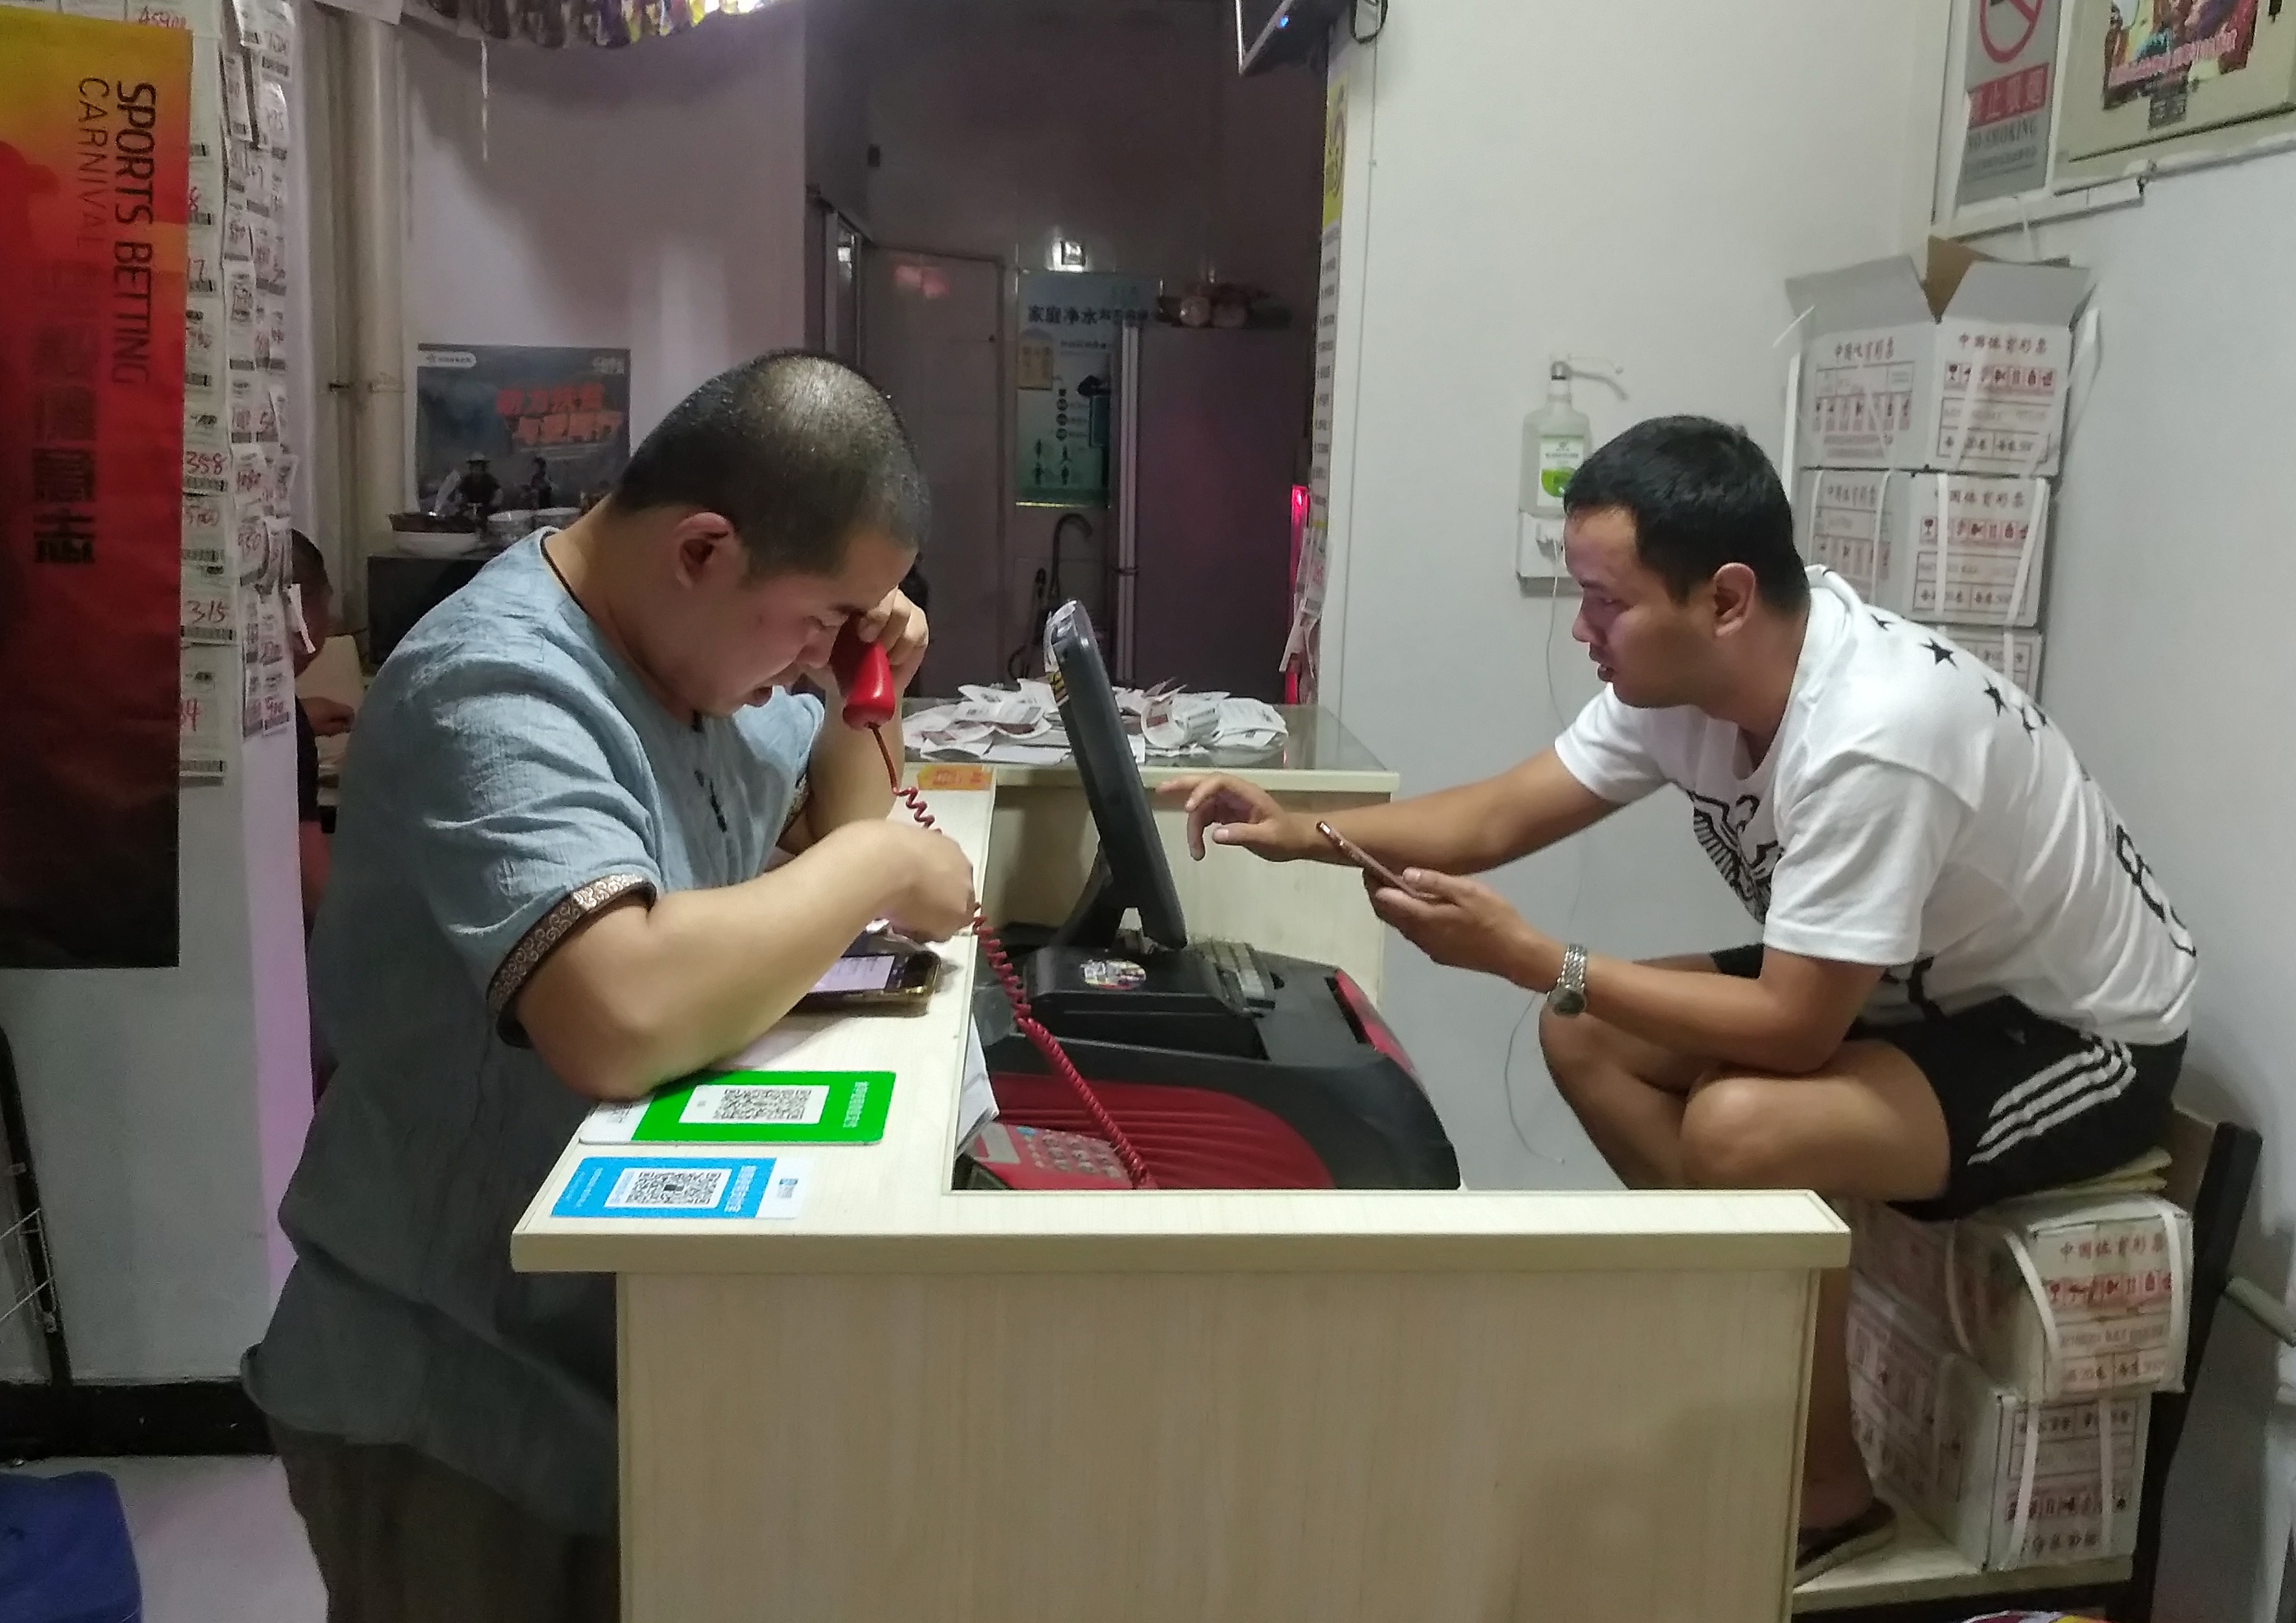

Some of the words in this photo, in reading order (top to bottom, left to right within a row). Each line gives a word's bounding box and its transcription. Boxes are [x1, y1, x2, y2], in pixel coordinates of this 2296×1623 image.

[77, 77, 110, 248] CARNIVAL
[115, 81, 157, 224] SPORTS
[113, 242, 153, 385] BETTING
[1934, 489, 2025, 509] 国体育彩票
[187, 599, 231, 624] 315
